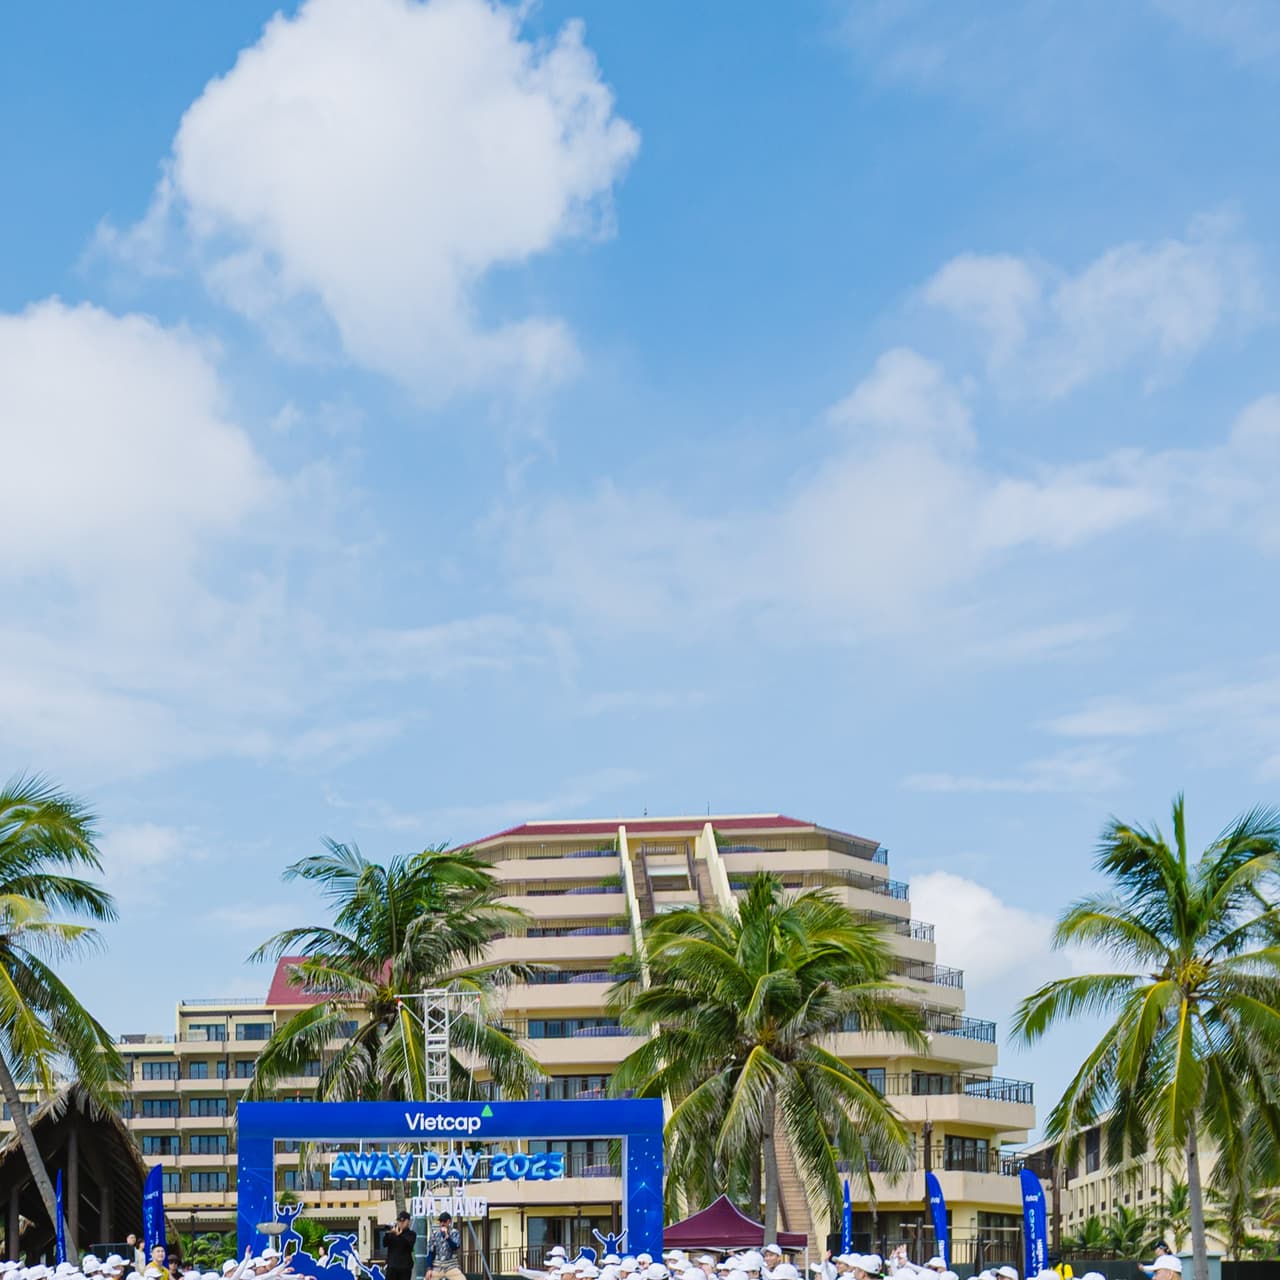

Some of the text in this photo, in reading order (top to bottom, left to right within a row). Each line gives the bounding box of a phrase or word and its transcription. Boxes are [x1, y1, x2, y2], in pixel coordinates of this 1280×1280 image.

[405, 1112, 481, 1134] Vietcap
[330, 1151, 564, 1181] AWAY DAY 2025
